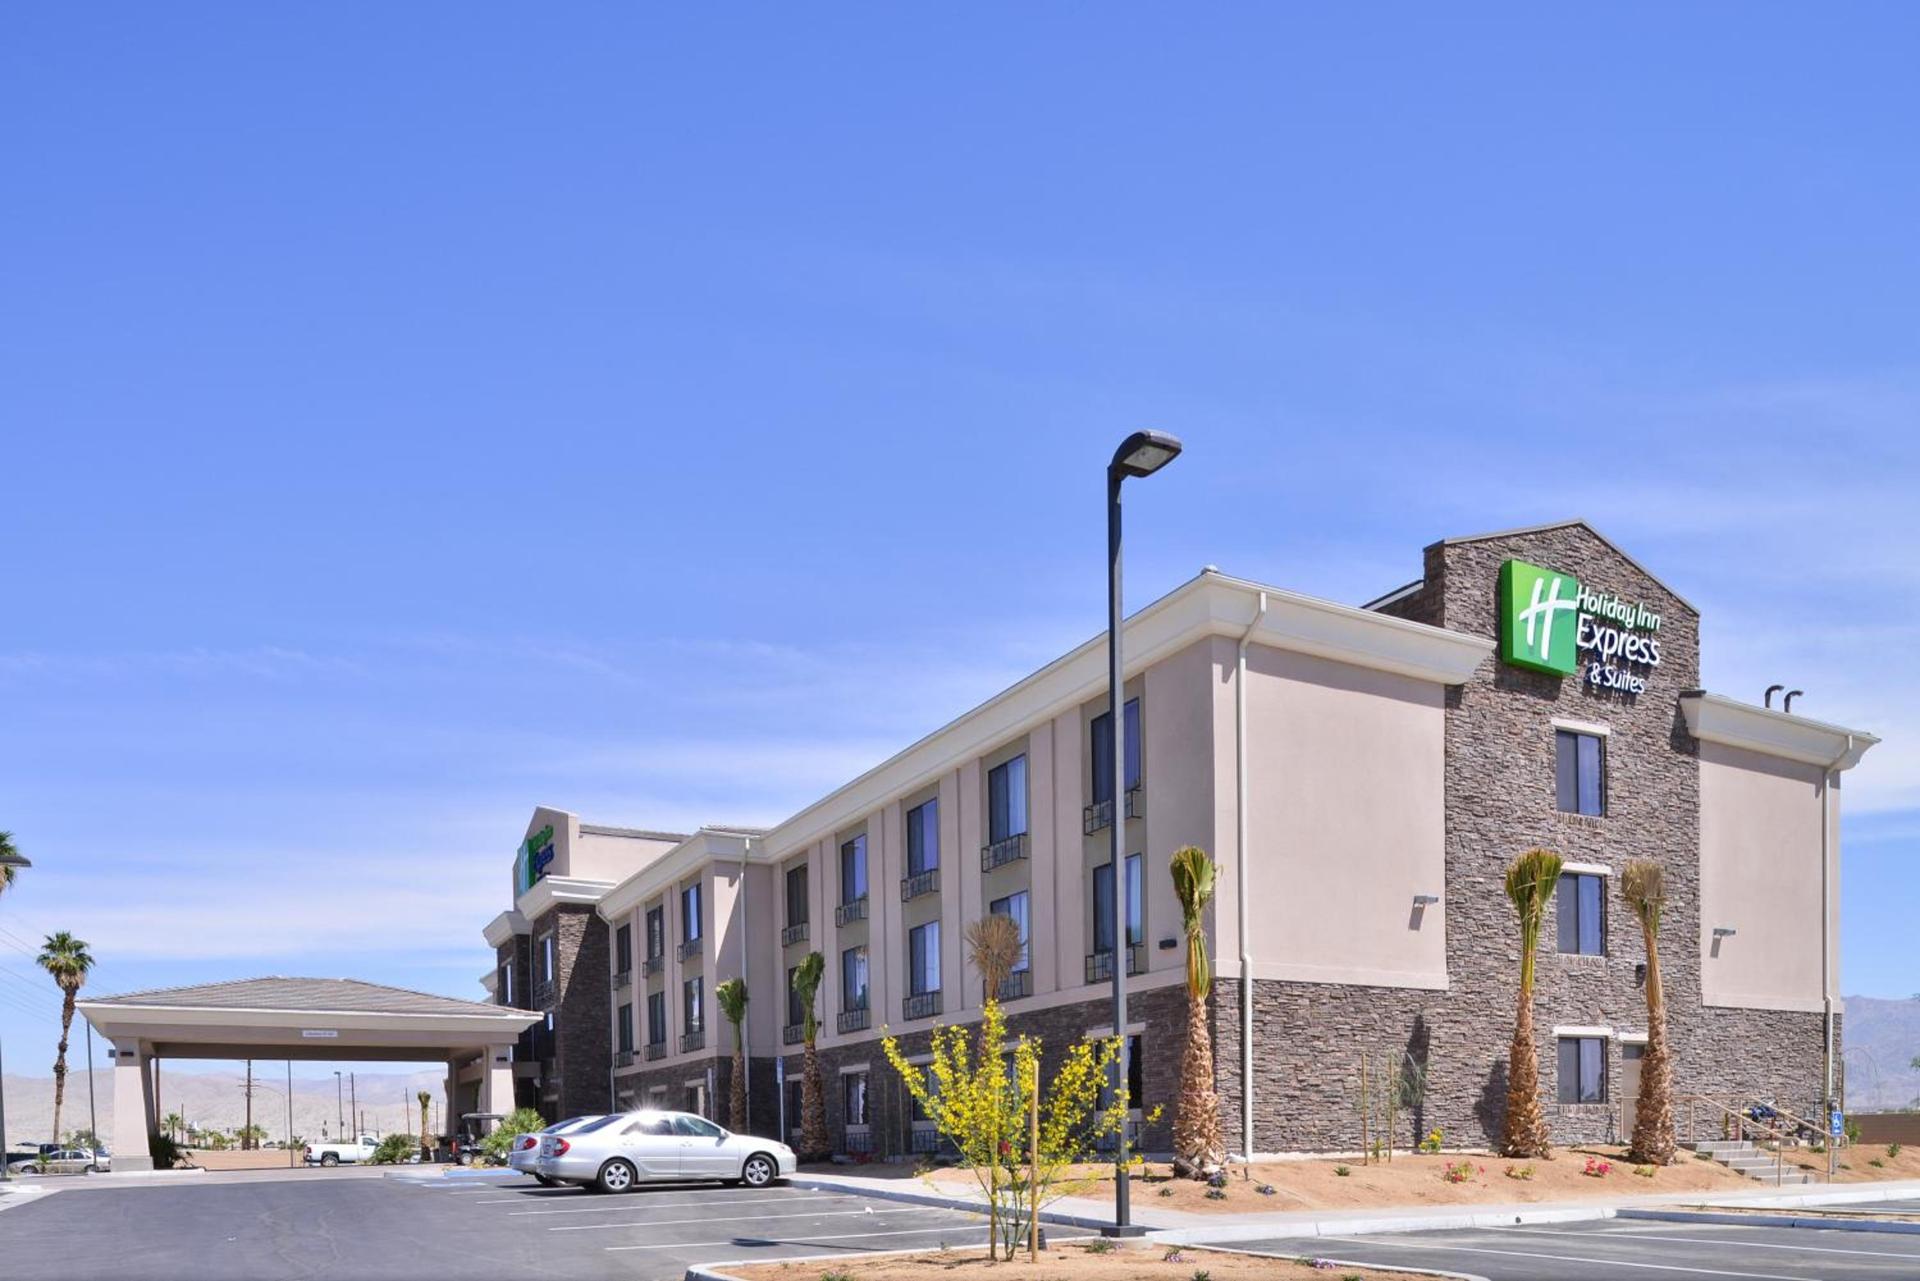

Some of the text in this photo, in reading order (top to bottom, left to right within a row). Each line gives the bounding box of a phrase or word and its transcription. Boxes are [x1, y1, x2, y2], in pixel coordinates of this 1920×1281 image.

[1577, 584, 1661, 630] Holiday Inn
[1576, 613, 1661, 665] Express
[1590, 663, 1645, 694] & Suites
